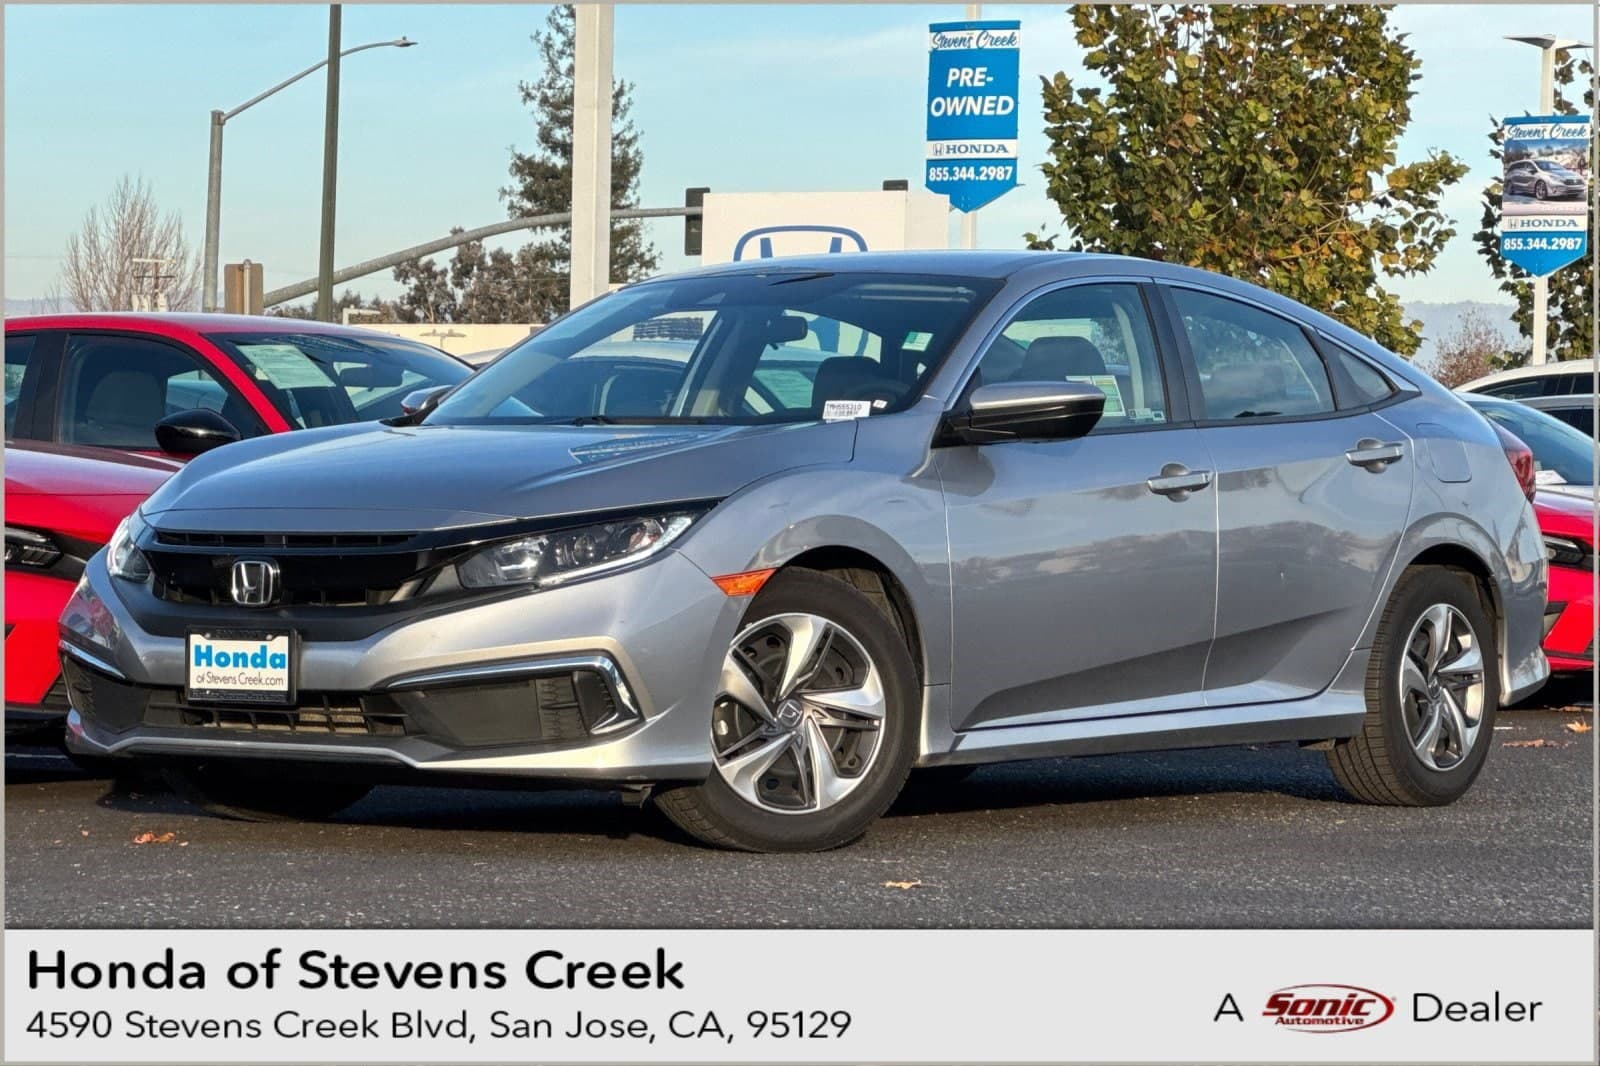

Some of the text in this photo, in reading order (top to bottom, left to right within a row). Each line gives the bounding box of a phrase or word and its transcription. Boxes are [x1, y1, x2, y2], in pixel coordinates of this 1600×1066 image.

[932, 30, 1017, 49] Stevens Creek
[947, 67, 994, 88] PRE-
[930, 95, 1014, 117] OWNED
[1507, 123, 1587, 139] Stevens Creek
[945, 144, 1009, 154] HONDA
[929, 166, 1013, 181] 855.344.2987
[1520, 219, 1578, 228] HONDA
[1504, 237, 1582, 250] 855.344.2987
[194, 644, 286, 669] Honda
[206, 671, 237, 685] Stevens
